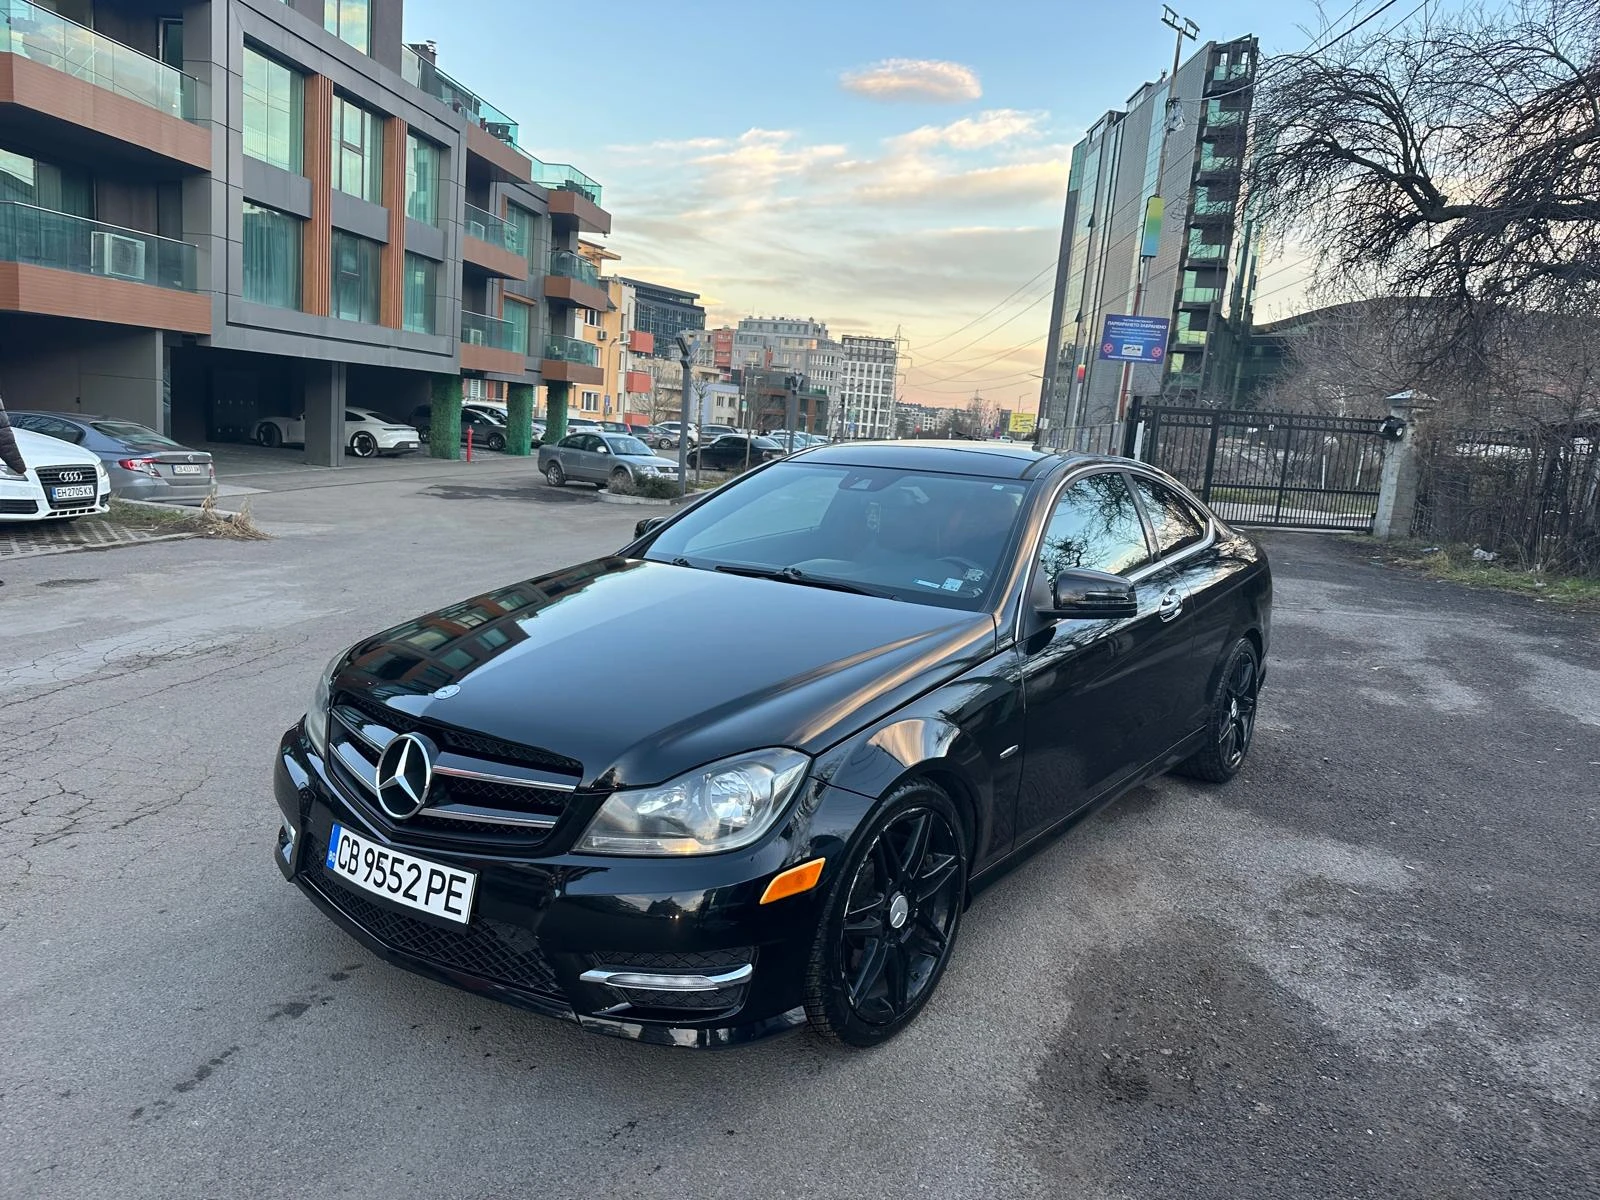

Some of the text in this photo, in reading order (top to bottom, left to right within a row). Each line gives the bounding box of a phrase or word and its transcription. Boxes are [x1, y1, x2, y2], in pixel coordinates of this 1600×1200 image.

[57, 486, 93, 497] EH 2705 KX
[337, 834, 467, 916] CB 9552 PE
